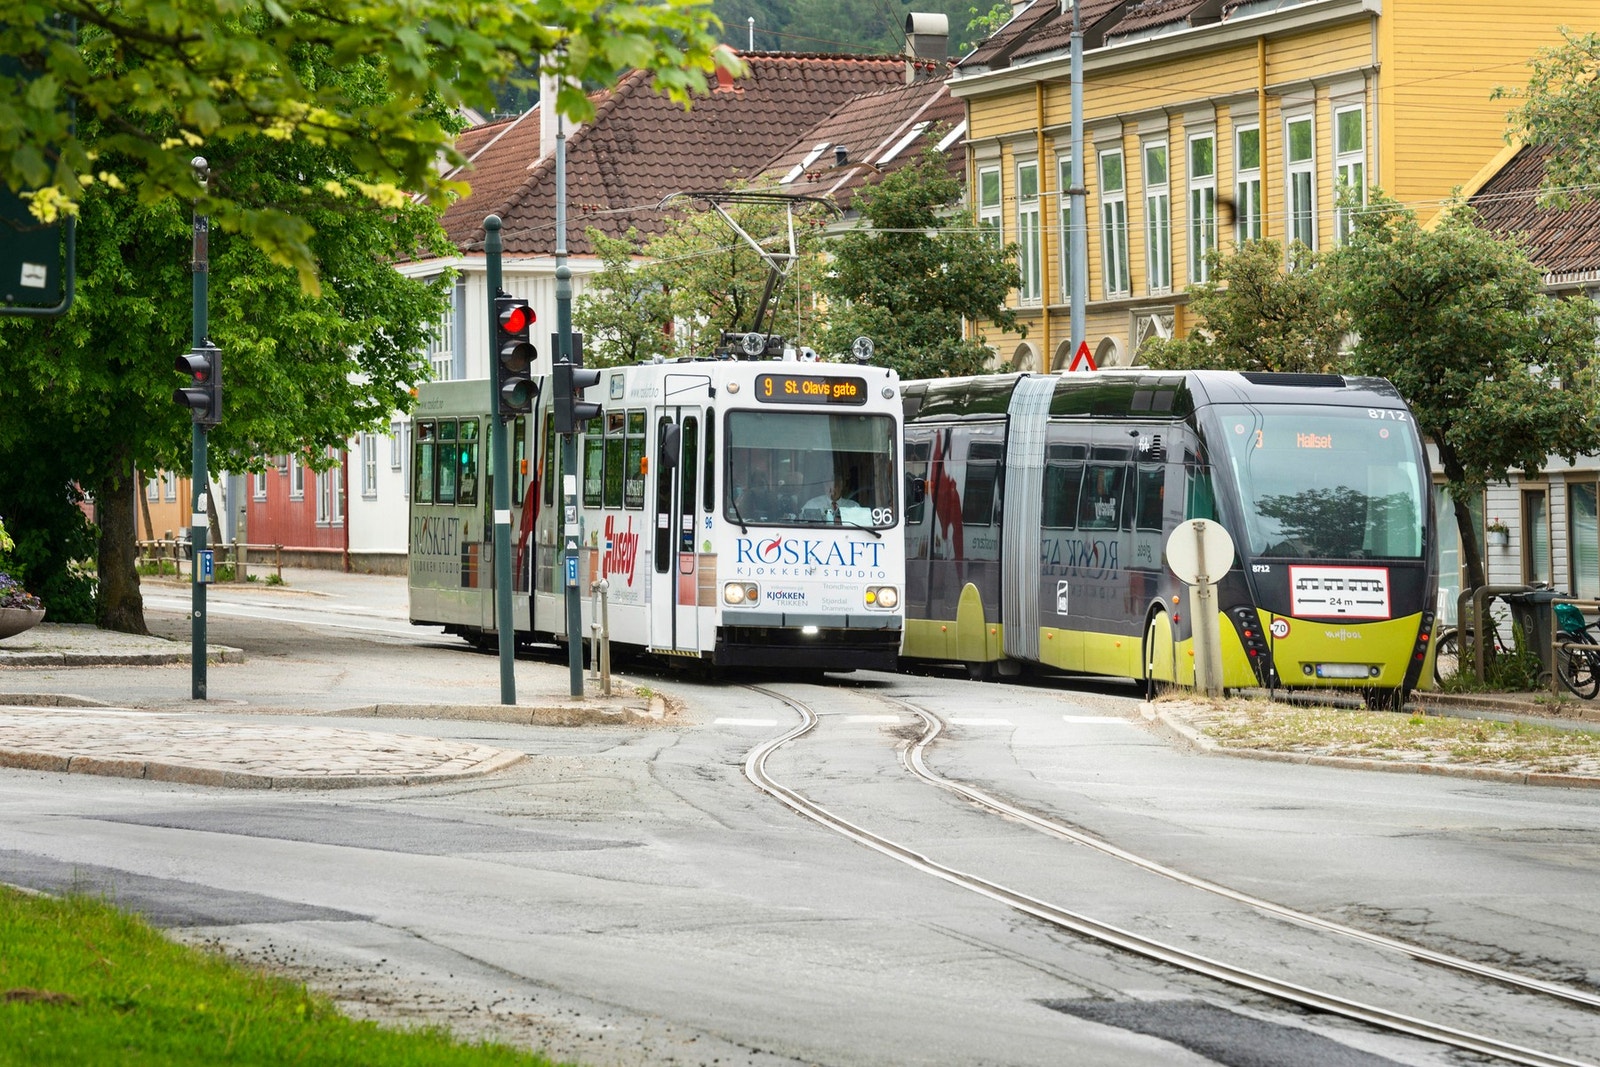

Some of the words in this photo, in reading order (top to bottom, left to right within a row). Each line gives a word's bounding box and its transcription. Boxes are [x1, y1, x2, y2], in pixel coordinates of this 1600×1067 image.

[764, 377, 773, 397] 9
[784, 380, 799, 394] St.
[802, 380, 830, 395] Olavs
[833, 382, 857, 398] gate
[1367, 408, 1408, 422] 8712
[1255, 429, 1264, 449] 3
[1296, 431, 1333, 449] Hallset
[871, 507, 893, 525] 96
[704, 516, 713, 530] 96
[602, 514, 640, 588] Huseby
[735, 536, 886, 568] RØSKAFT
[736, 566, 811, 577] KJØKKEN
[824, 569, 887, 579] STUDIO
[1251, 564, 1271, 573] 8712
[823, 582, 859, 591] Trondheim
[766, 590, 805, 600] KJØKKEN
[1329, 597, 1342, 606] 24
[776, 599, 808, 607] TRIKKEN
[1273, 623, 1286, 633] 70
